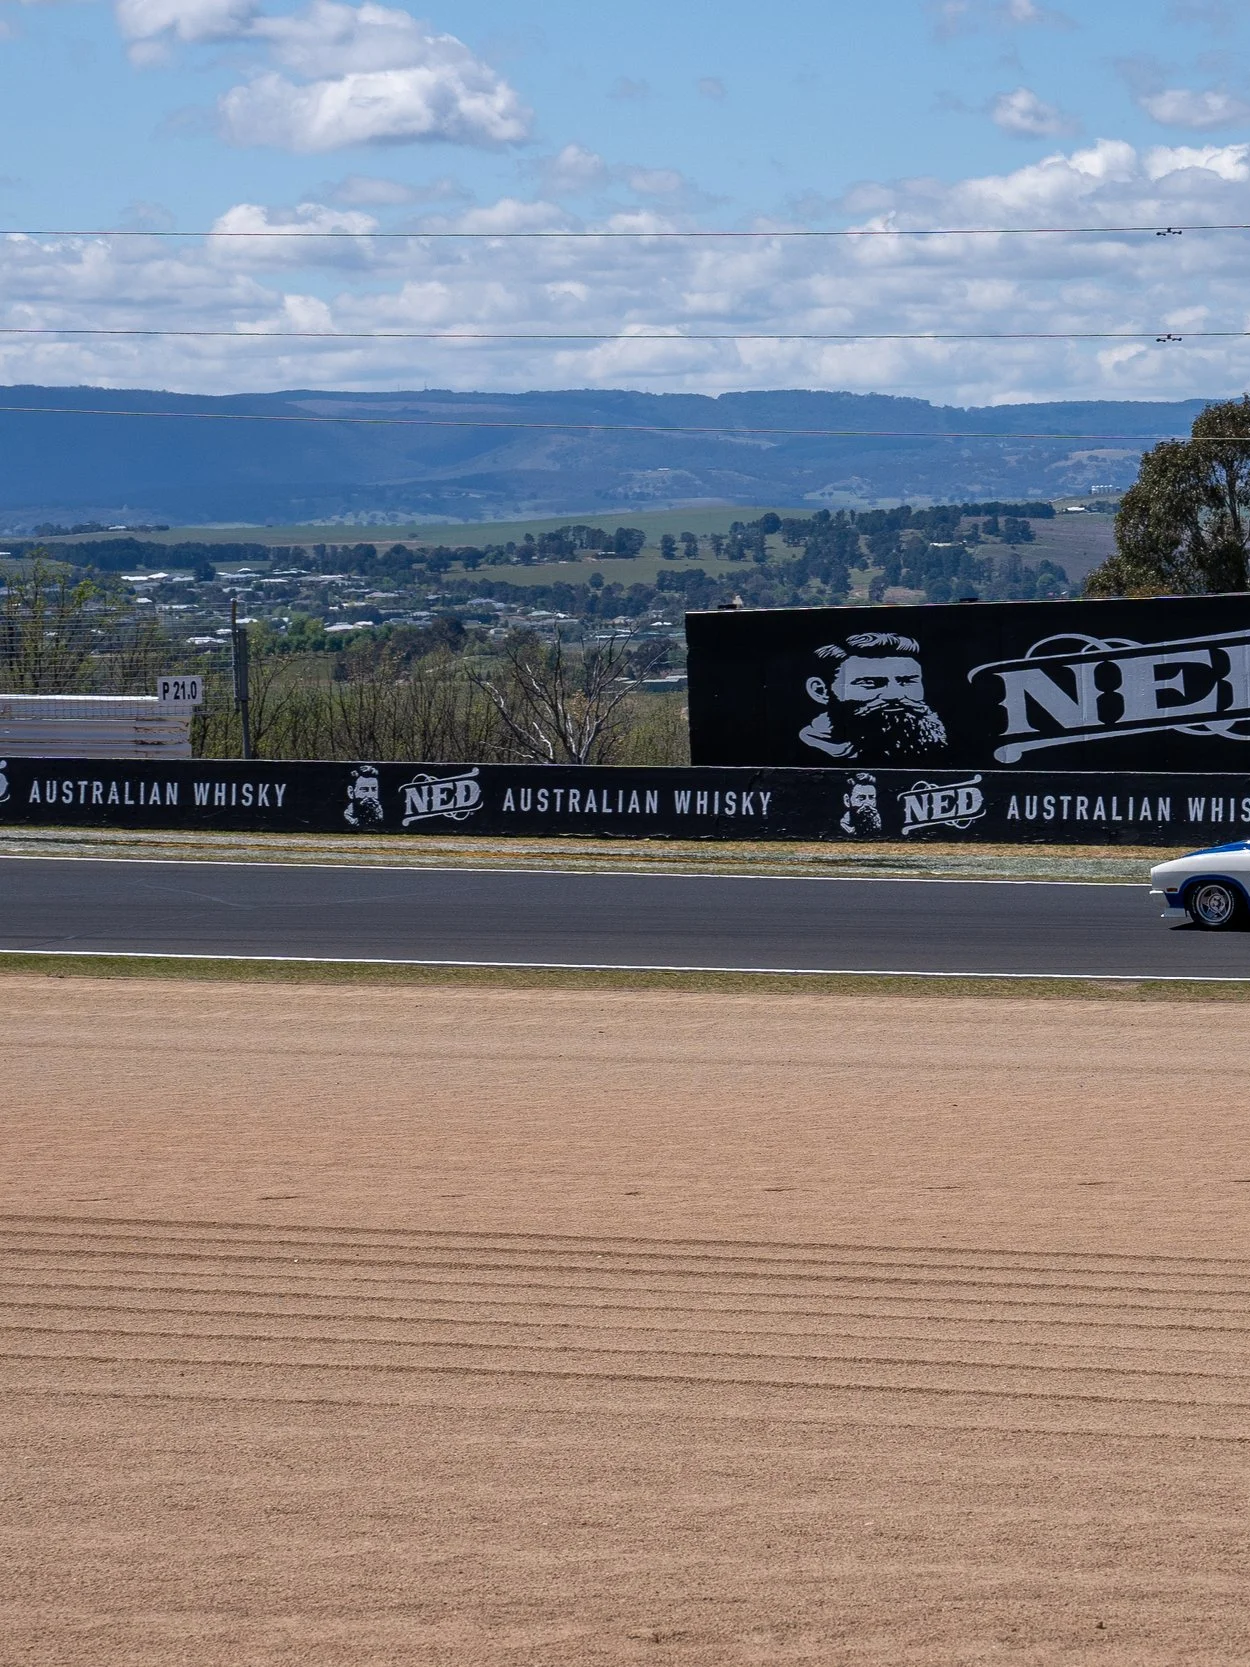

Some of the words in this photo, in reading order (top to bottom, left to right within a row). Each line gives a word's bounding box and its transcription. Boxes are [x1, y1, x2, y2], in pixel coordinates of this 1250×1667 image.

[162, 682, 170, 700] P
[173, 681, 197, 700] 21.0
[29, 780, 178, 806] AUSTRALIAN
[193, 783, 287, 807] WHISKY
[404, 780, 481, 815] NED
[503, 788, 658, 814] AUSTRALIAN
[674, 791, 771, 816] WHISKY
[904, 788, 985, 824] NED
[1007, 795, 1171, 822] AUSTRALIAN
